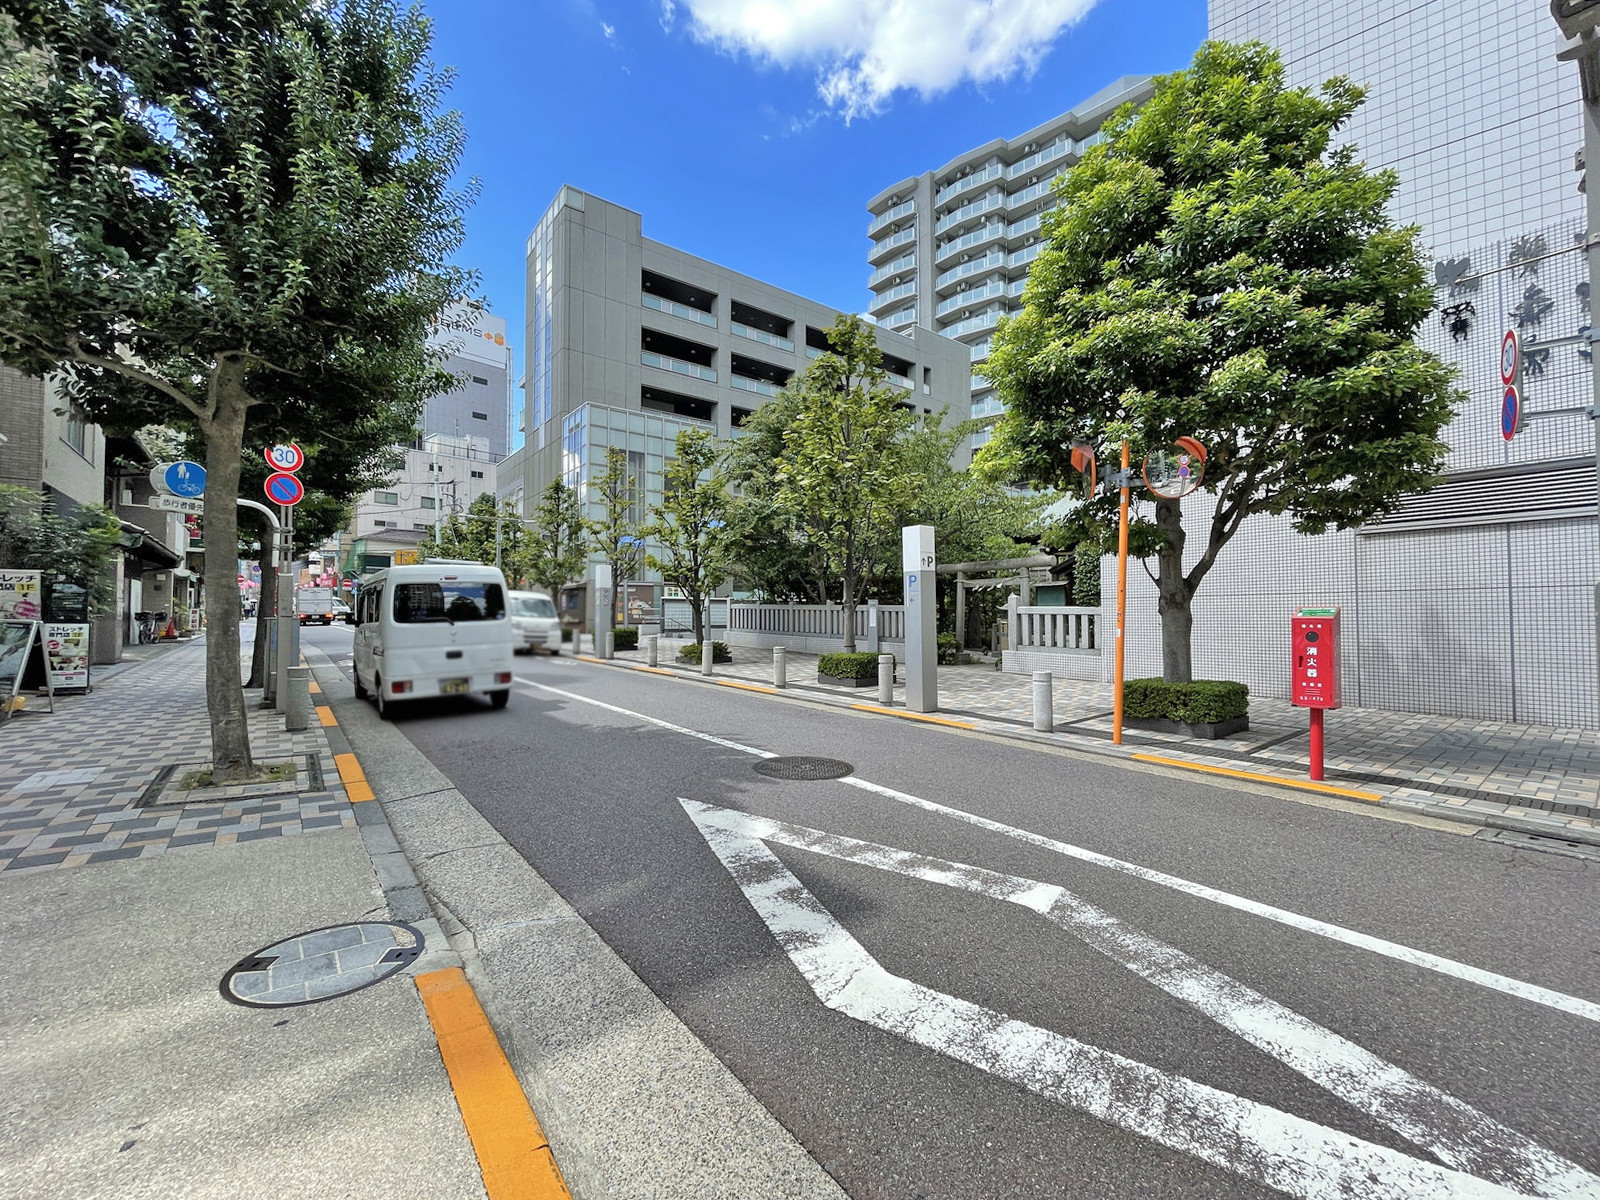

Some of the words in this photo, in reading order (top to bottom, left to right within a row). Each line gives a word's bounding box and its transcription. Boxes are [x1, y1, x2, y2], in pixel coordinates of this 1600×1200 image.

[274, 448, 295, 464] 30
[163, 498, 204, 512] 歩行者優先
[927, 556, 933, 567] P
[909, 575, 917, 587] P
[1306, 647, 1318, 678] 消火器
